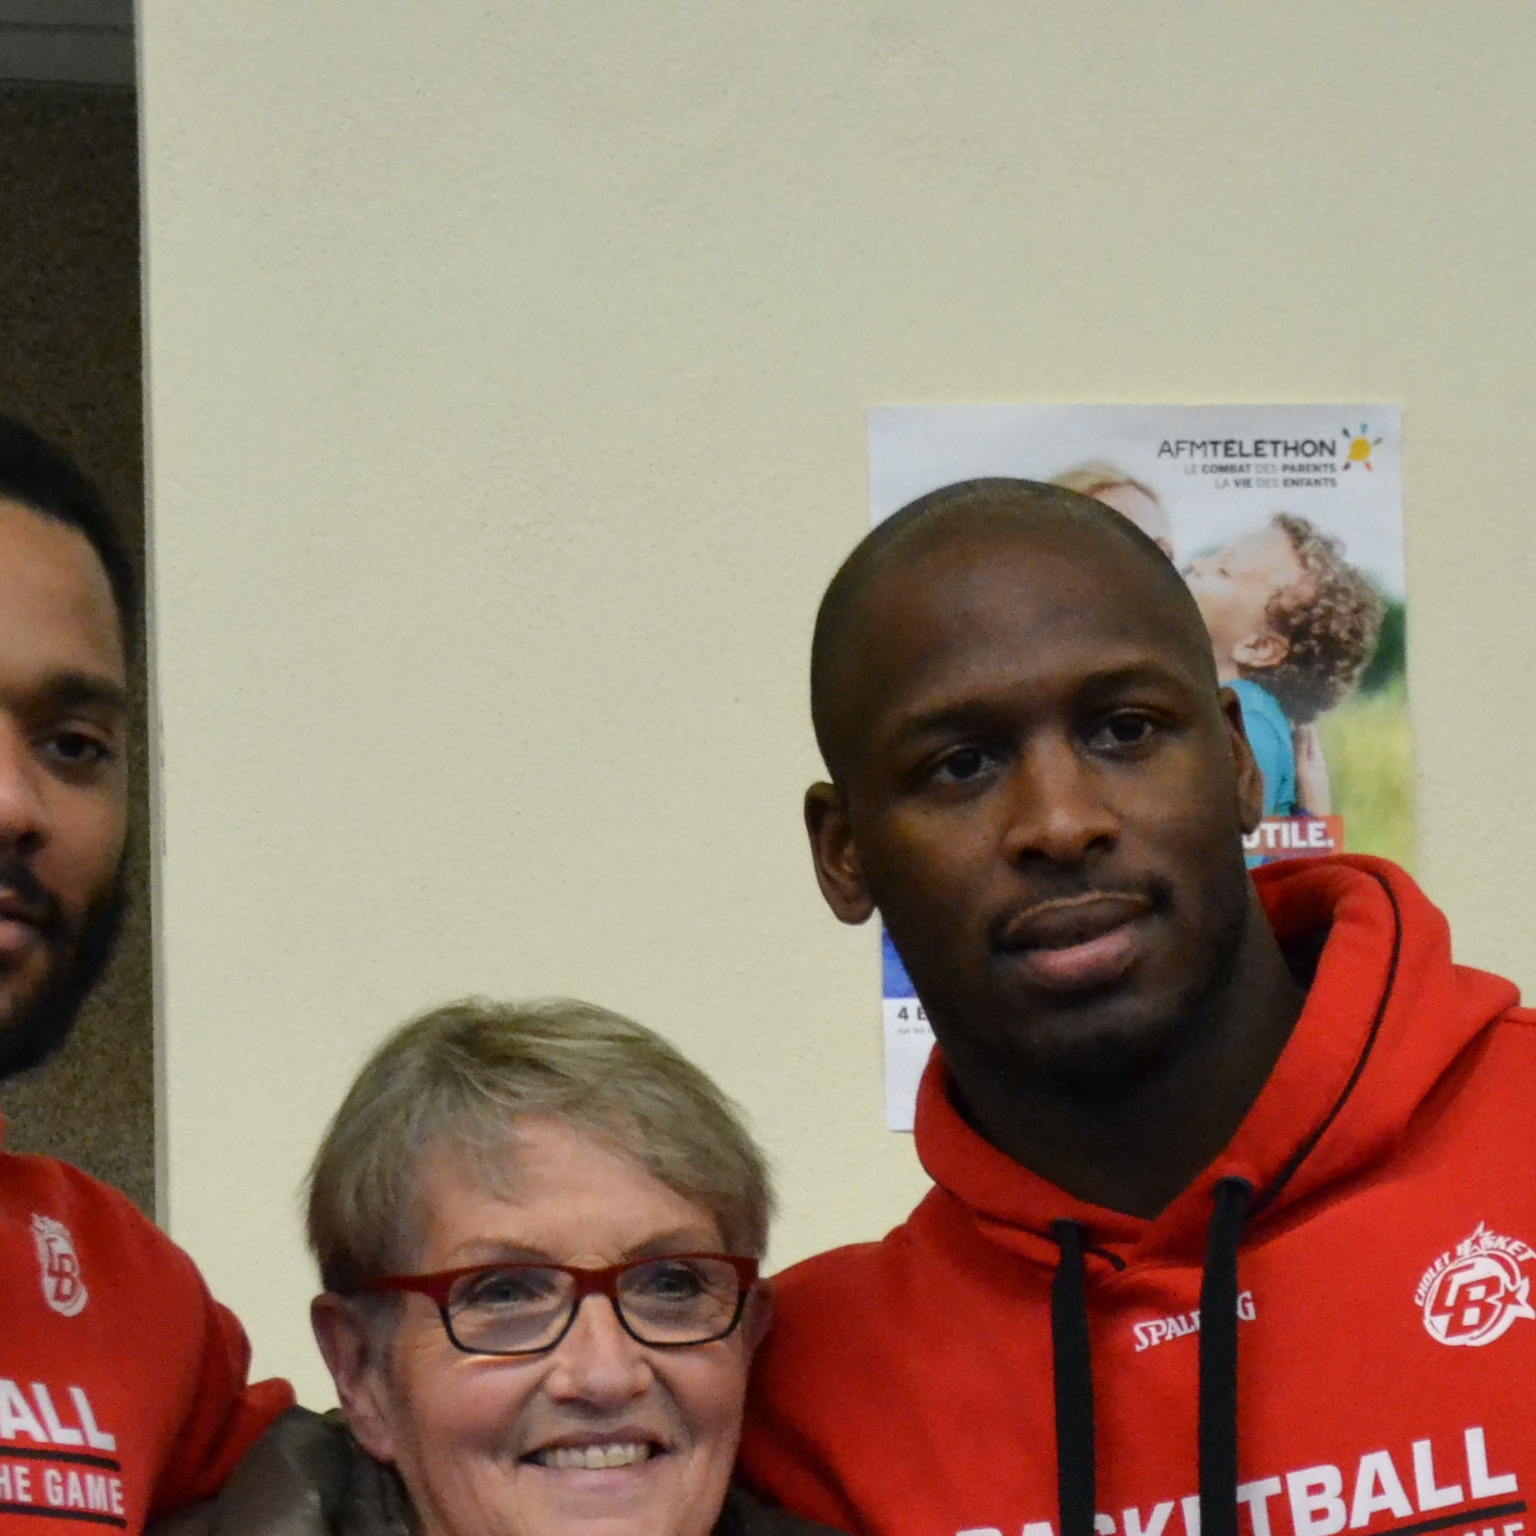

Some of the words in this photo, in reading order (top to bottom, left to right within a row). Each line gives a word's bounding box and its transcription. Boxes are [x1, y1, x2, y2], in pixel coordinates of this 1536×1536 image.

[1201, 463, 1252, 474] COMBAT
[1282, 463, 1338, 474] PARENTS
[1234, 478, 1252, 488] VIE
[1282, 477, 1338, 488] ENFANTS
[897, 1006, 909, 1020] 4
[1133, 1290, 1257, 1352] SPALG
[44, 1467, 125, 1516] GAME
